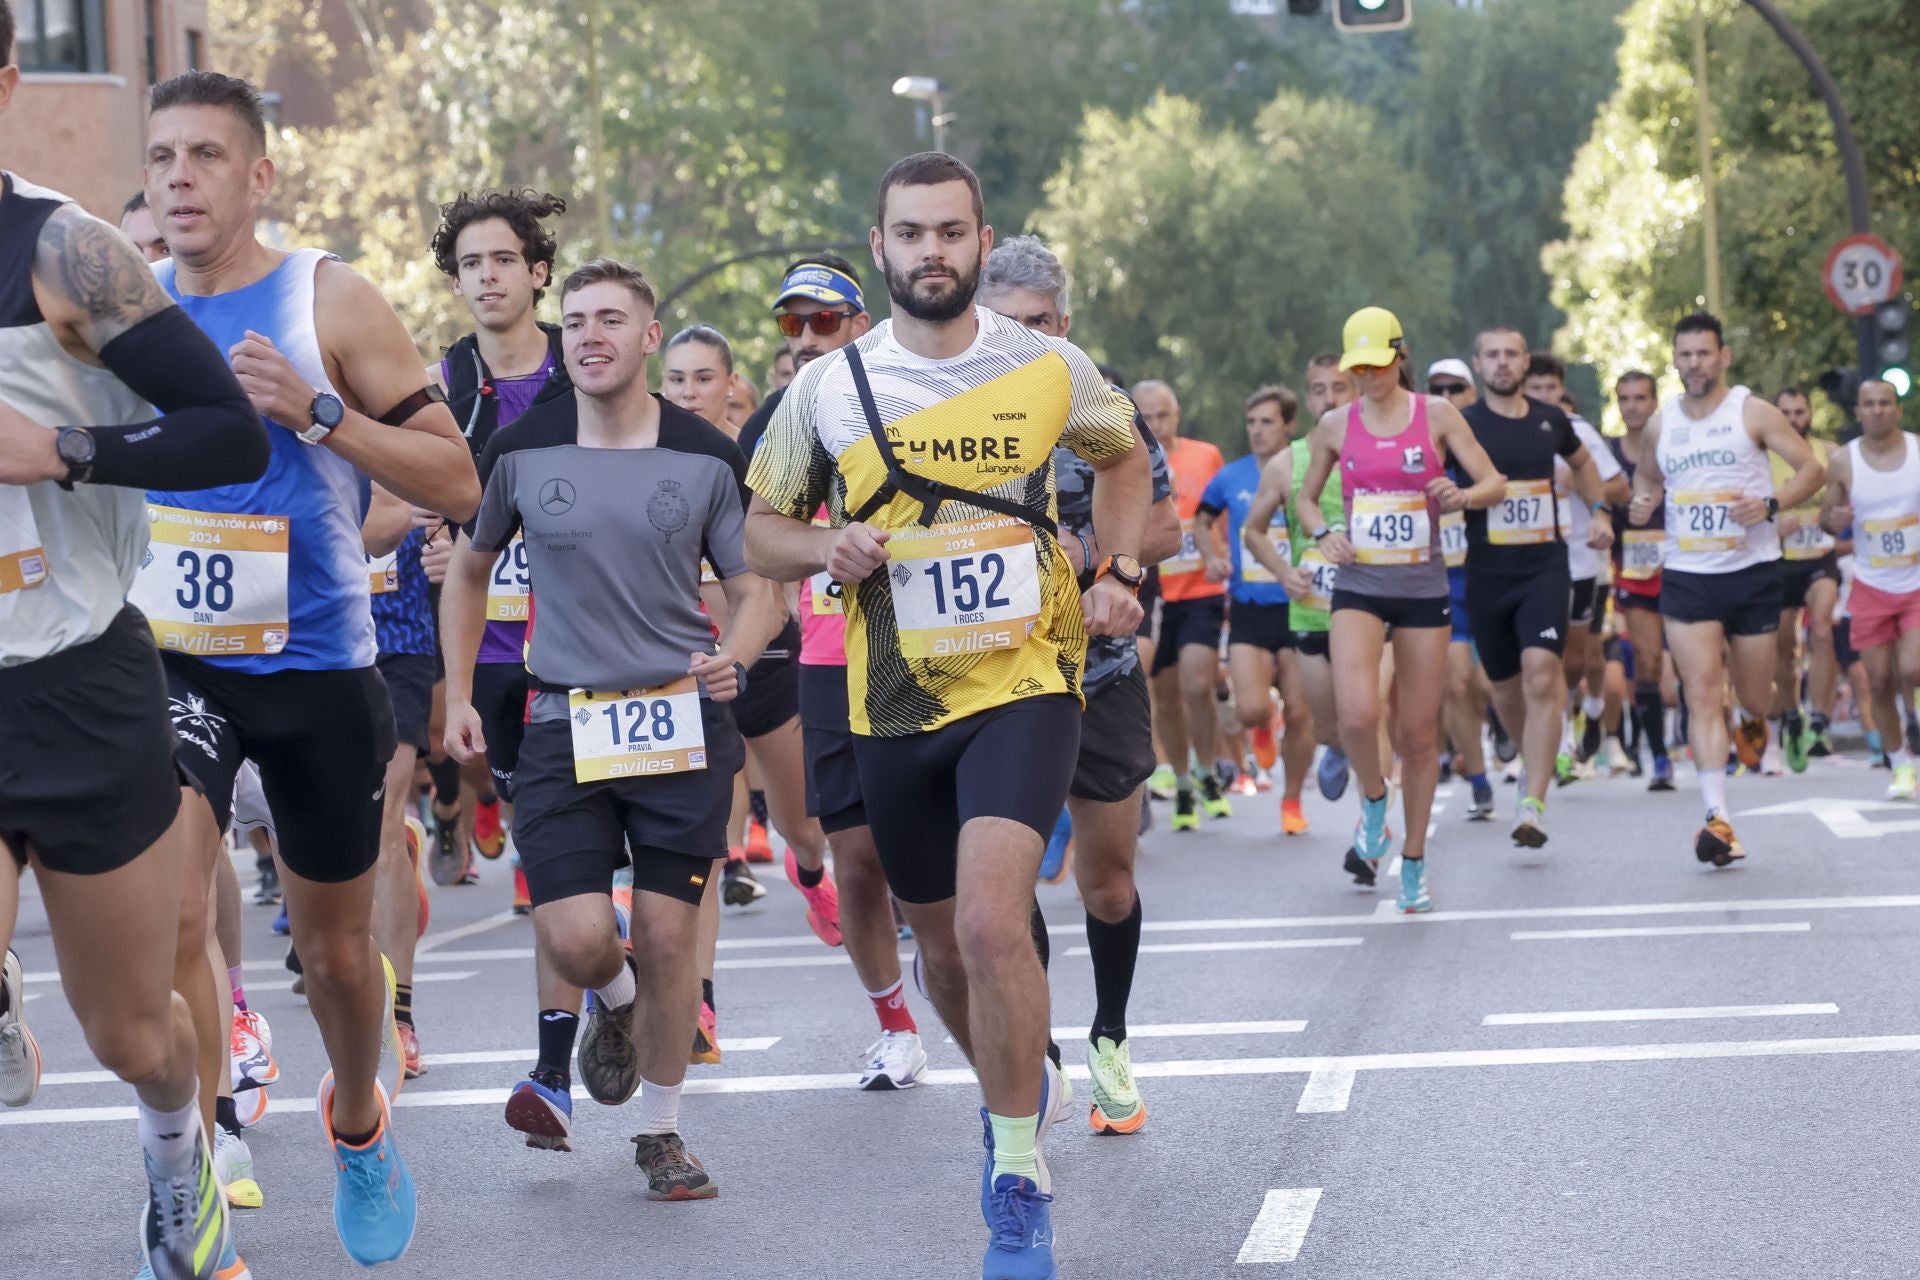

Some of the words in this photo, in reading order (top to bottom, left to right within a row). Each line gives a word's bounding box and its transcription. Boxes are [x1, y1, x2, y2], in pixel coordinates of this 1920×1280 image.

[1843, 261, 1881, 289] 30
[992, 412, 1027, 421] VESKIN
[1665, 449, 1736, 475] bathco
[164, 513, 193, 526] MEDIA
[193, 517, 248, 530] MARATÓN
[1503, 498, 1541, 523] 367
[1689, 505, 1729, 531] 287
[188, 531, 222, 544] 2024
[916, 527, 946, 539] MEDIA
[947, 519, 997, 536] MARATÓN
[998, 517, 1021, 529] AVIL
[1368, 514, 1414, 541] 439
[944, 538, 976, 551] 2024
[1882, 529, 1905, 554] 89
[495, 541, 531, 586] 29
[176, 550, 234, 612] 38
[924, 552, 1010, 615] 152
[193, 612, 214, 624] DANI
[499, 601, 530, 617] avi
[959, 612, 985, 625] ROCES
[163, 630, 247, 651] avilés
[934, 629, 1012, 654] avilés
[602, 699, 675, 746] 128
[628, 743, 653, 753] PRAVIA
